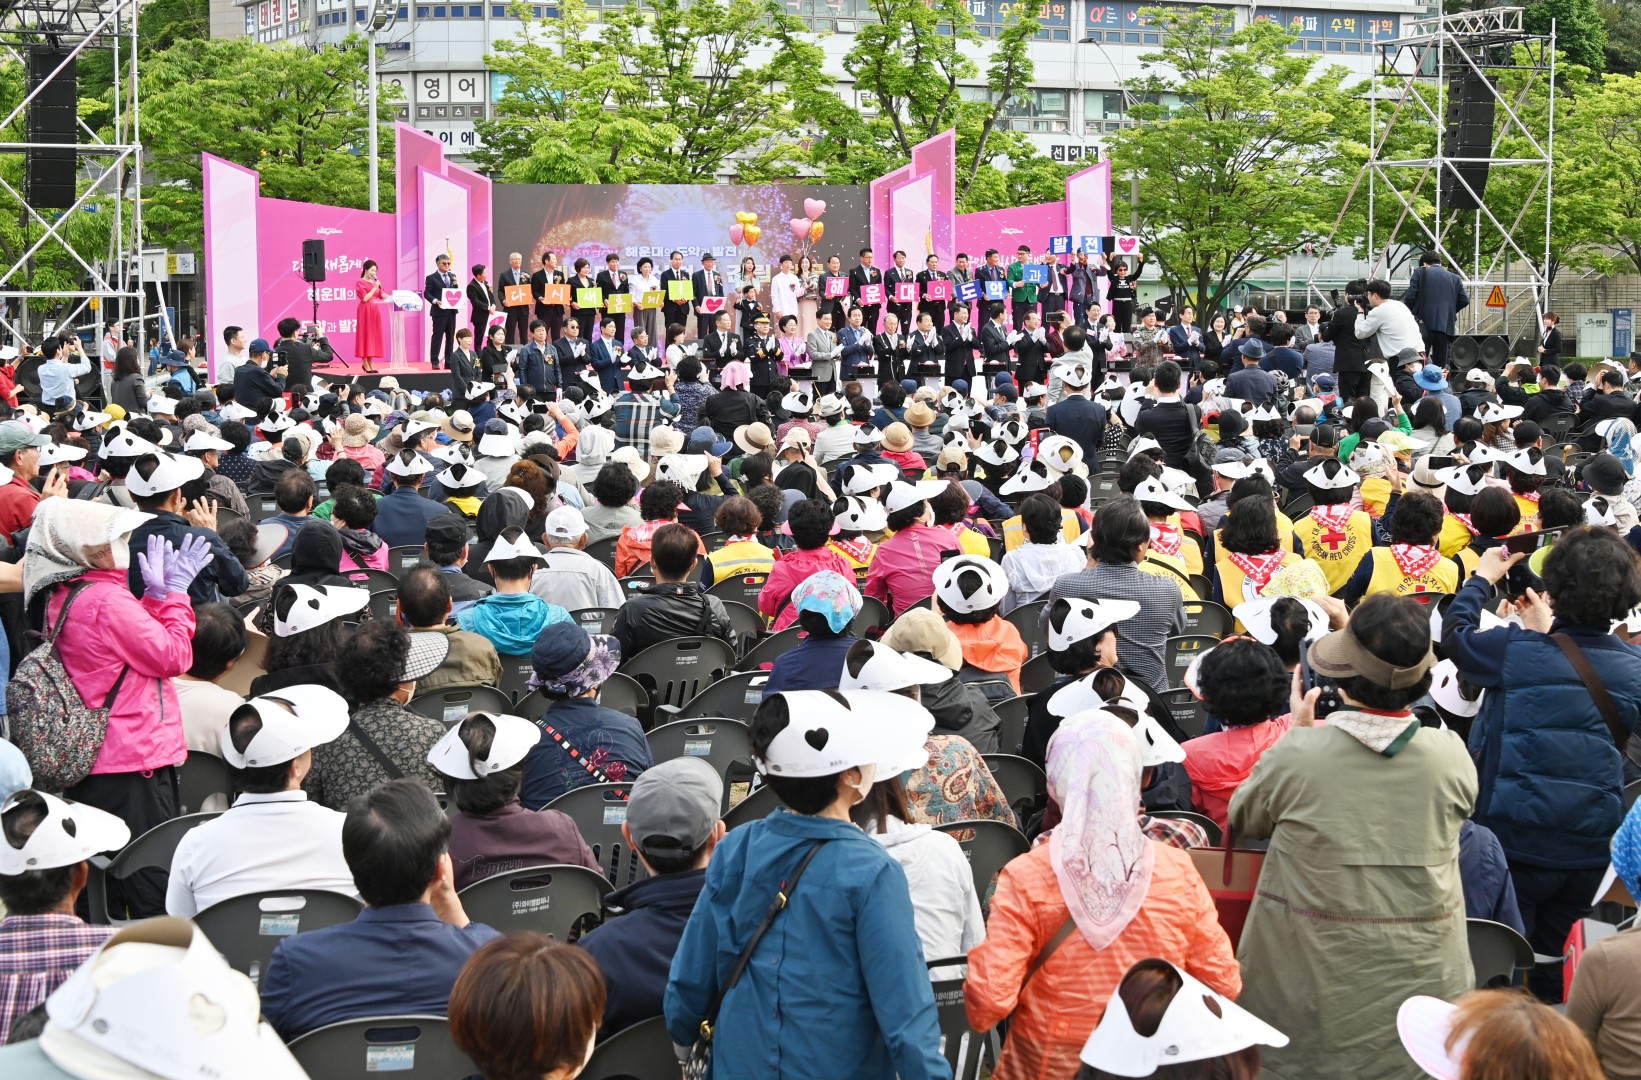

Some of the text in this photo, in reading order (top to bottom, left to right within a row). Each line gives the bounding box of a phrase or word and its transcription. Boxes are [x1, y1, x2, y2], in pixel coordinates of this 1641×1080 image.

[1037, 4, 1066, 20] 과학
[1331, 18, 1355, 33] 수학
[1368, 19, 1393, 35] 과학
[625, 246, 671, 257] 해운대의
[712, 246, 737, 257] 발전
[1053, 237, 1098, 253] 발 전
[1029, 270, 1041, 282] 과
[511, 288, 526, 302] 다
[552, 287, 563, 302] 시
[584, 291, 597, 304] 새
[830, 279, 945, 302] 해 운 대 의
[961, 282, 1004, 300] 도 약
[1330, 551, 1343, 561] RED
[1342, 535, 1357, 556] CROSS
